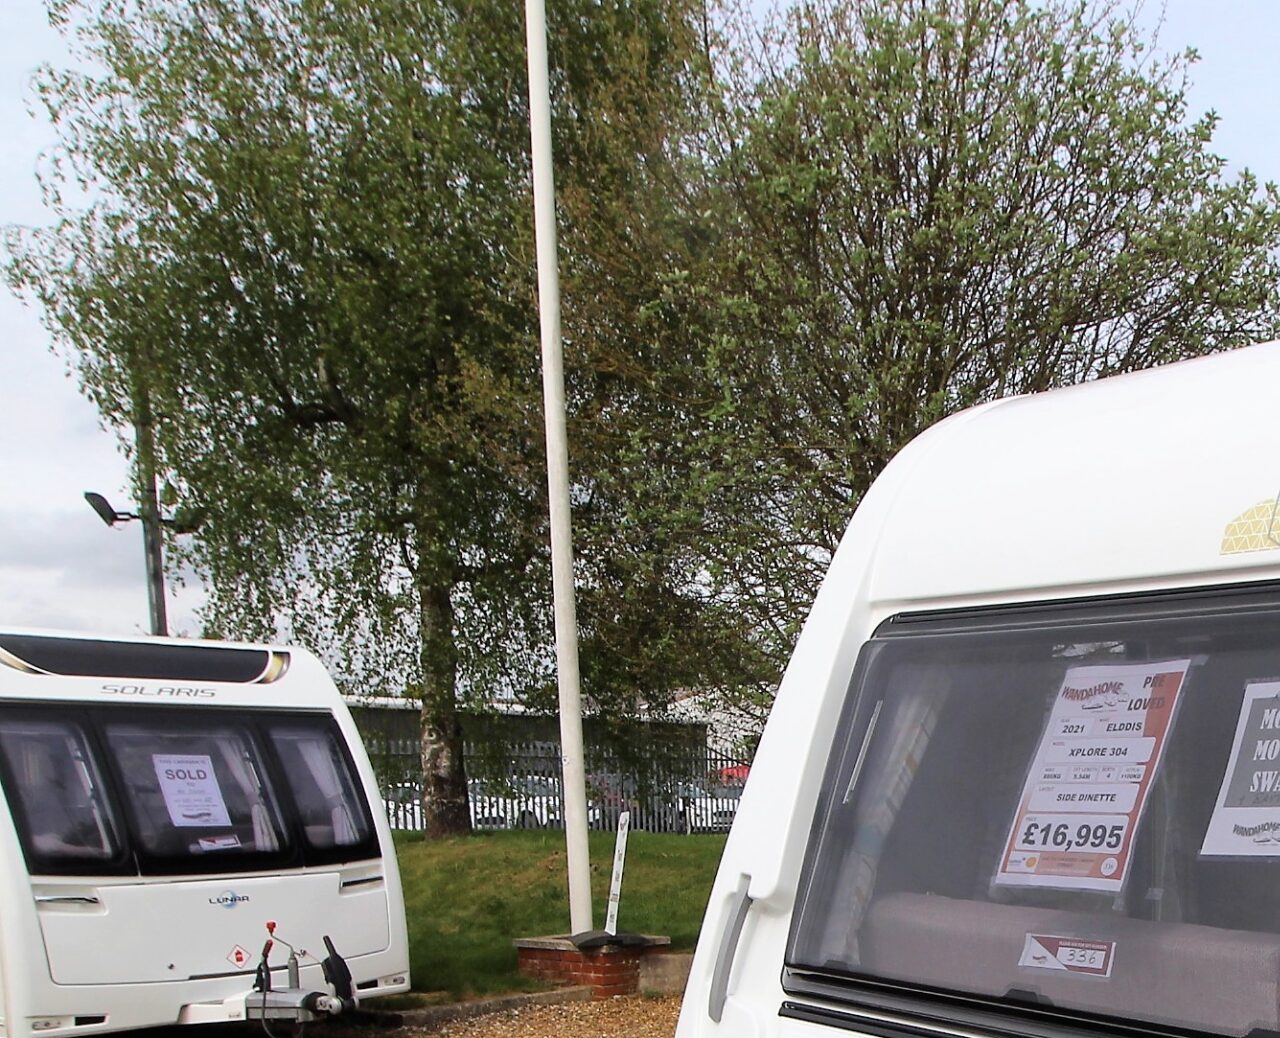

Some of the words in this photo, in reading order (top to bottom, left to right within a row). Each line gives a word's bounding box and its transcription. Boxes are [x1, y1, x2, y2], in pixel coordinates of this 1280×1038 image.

[1142, 675, 1166, 689] PRE
[100, 684, 217, 698] SOLARIS
[1061, 680, 1124, 702] WANDAHOME
[1127, 697, 1167, 712] LOVED
[1062, 724, 1085, 734] 2021
[1105, 721, 1143, 732] ELDDIS
[1068, 748, 1108, 757] XPLORE
[1109, 747, 1128, 757] 304
[164, 769, 207, 780] SOLD
[1056, 793, 1077, 802] SIDE
[1078, 793, 1117, 802] DINETTE
[1021, 822, 1124, 852] £16,995
[208, 895, 250, 905] LUNAR
[1066, 949, 1097, 965] 336
